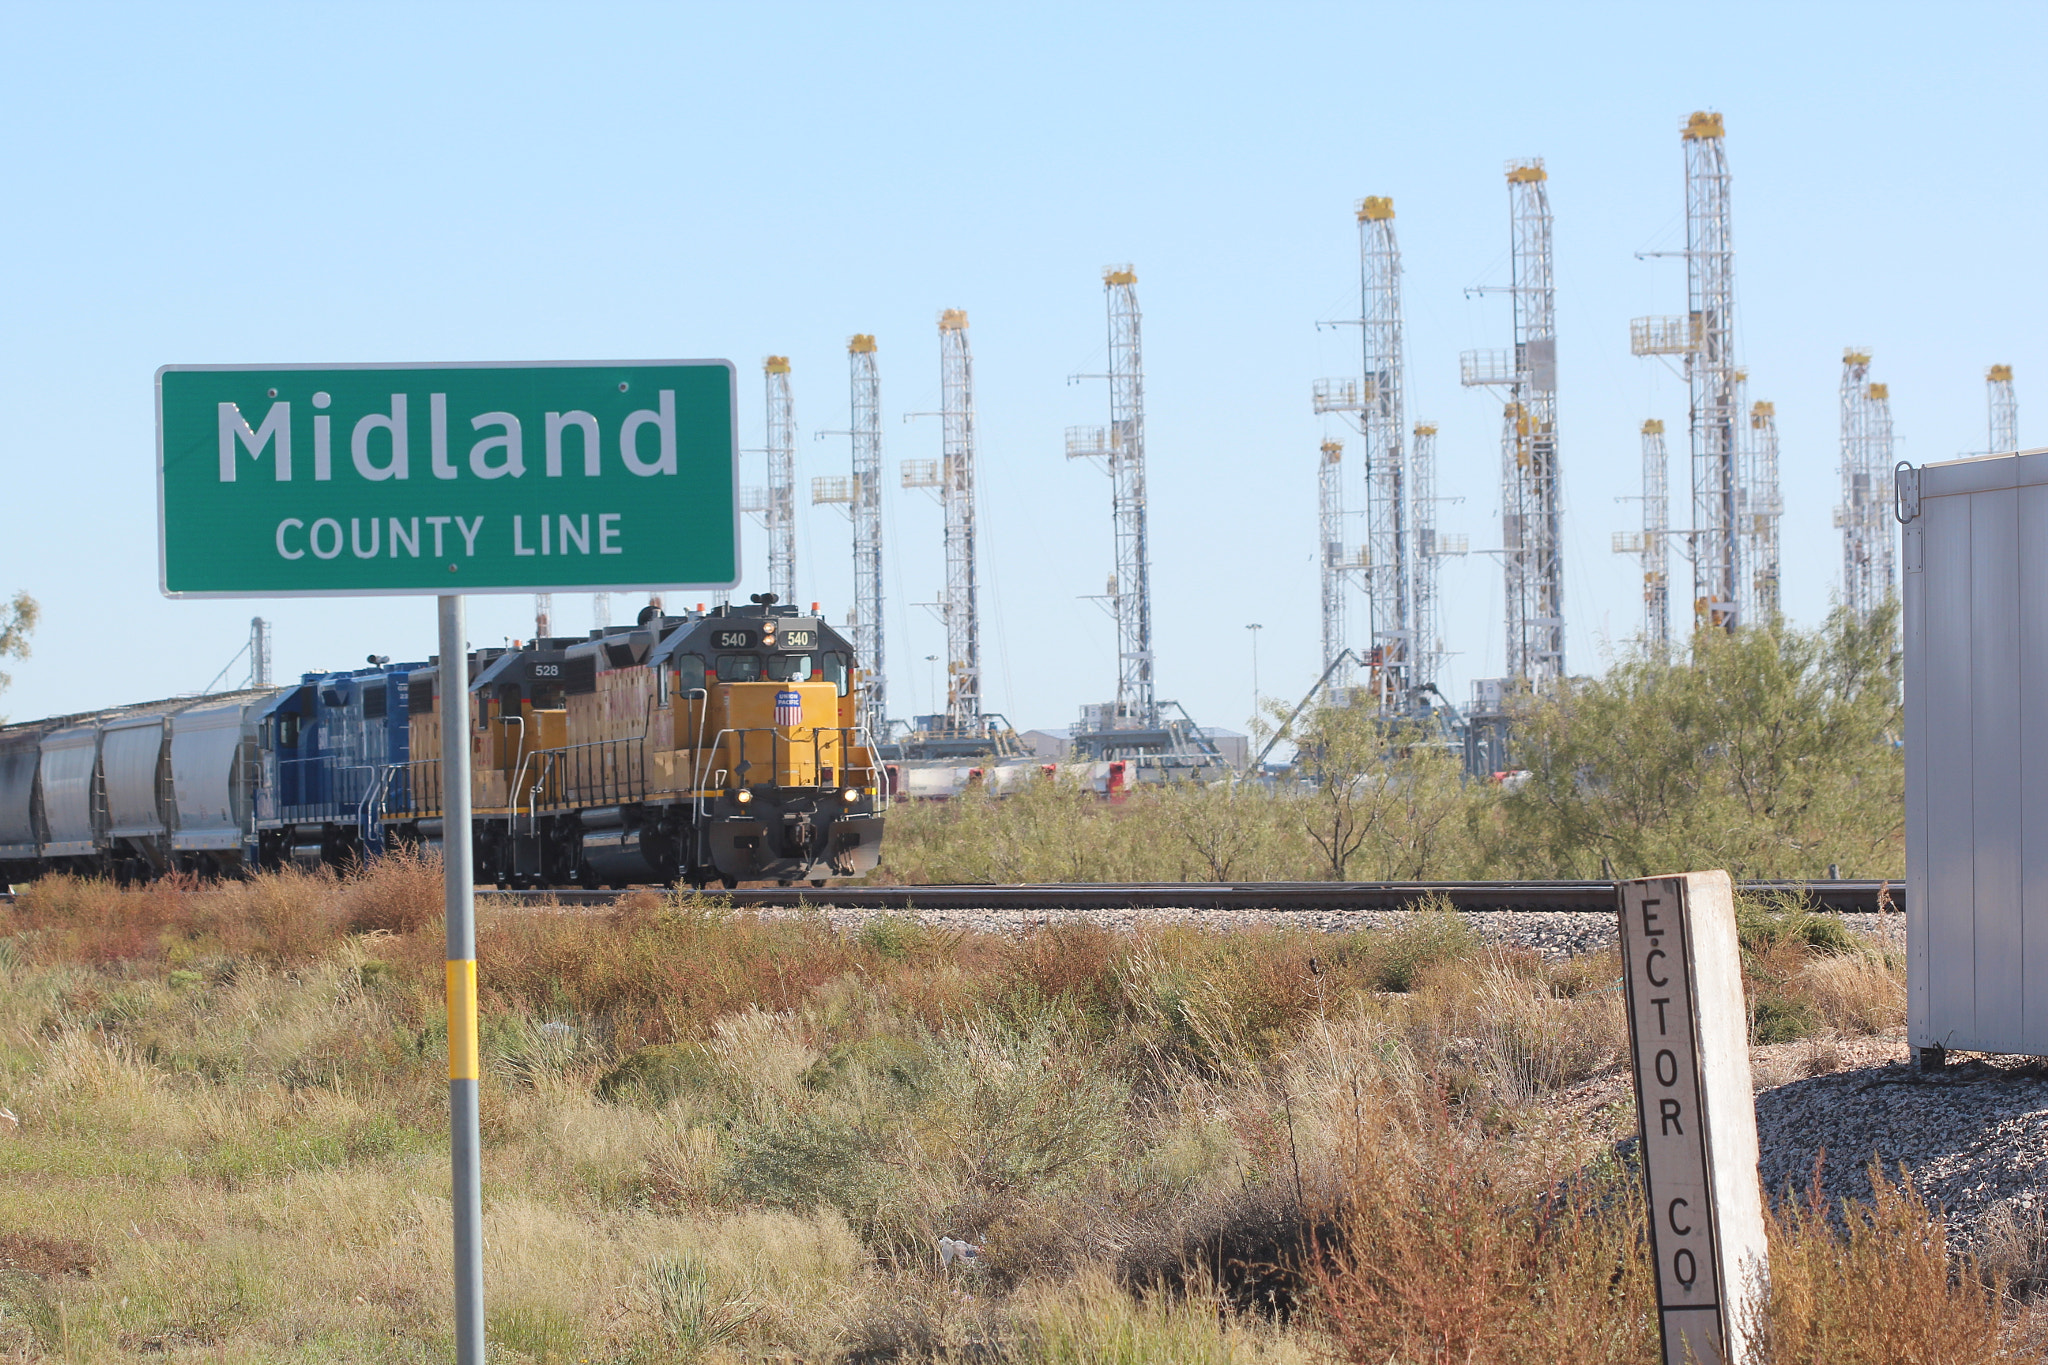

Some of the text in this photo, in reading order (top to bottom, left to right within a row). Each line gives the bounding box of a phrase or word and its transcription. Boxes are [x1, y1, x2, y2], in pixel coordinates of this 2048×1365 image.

[217, 389, 678, 483] Midland
[275, 512, 623, 560] COUNTY LINE
[721, 632, 747, 647] 540
[787, 631, 809, 646] 540
[535, 664, 559, 676] 528
[1641, 898, 1697, 1287] ECTOR CO
